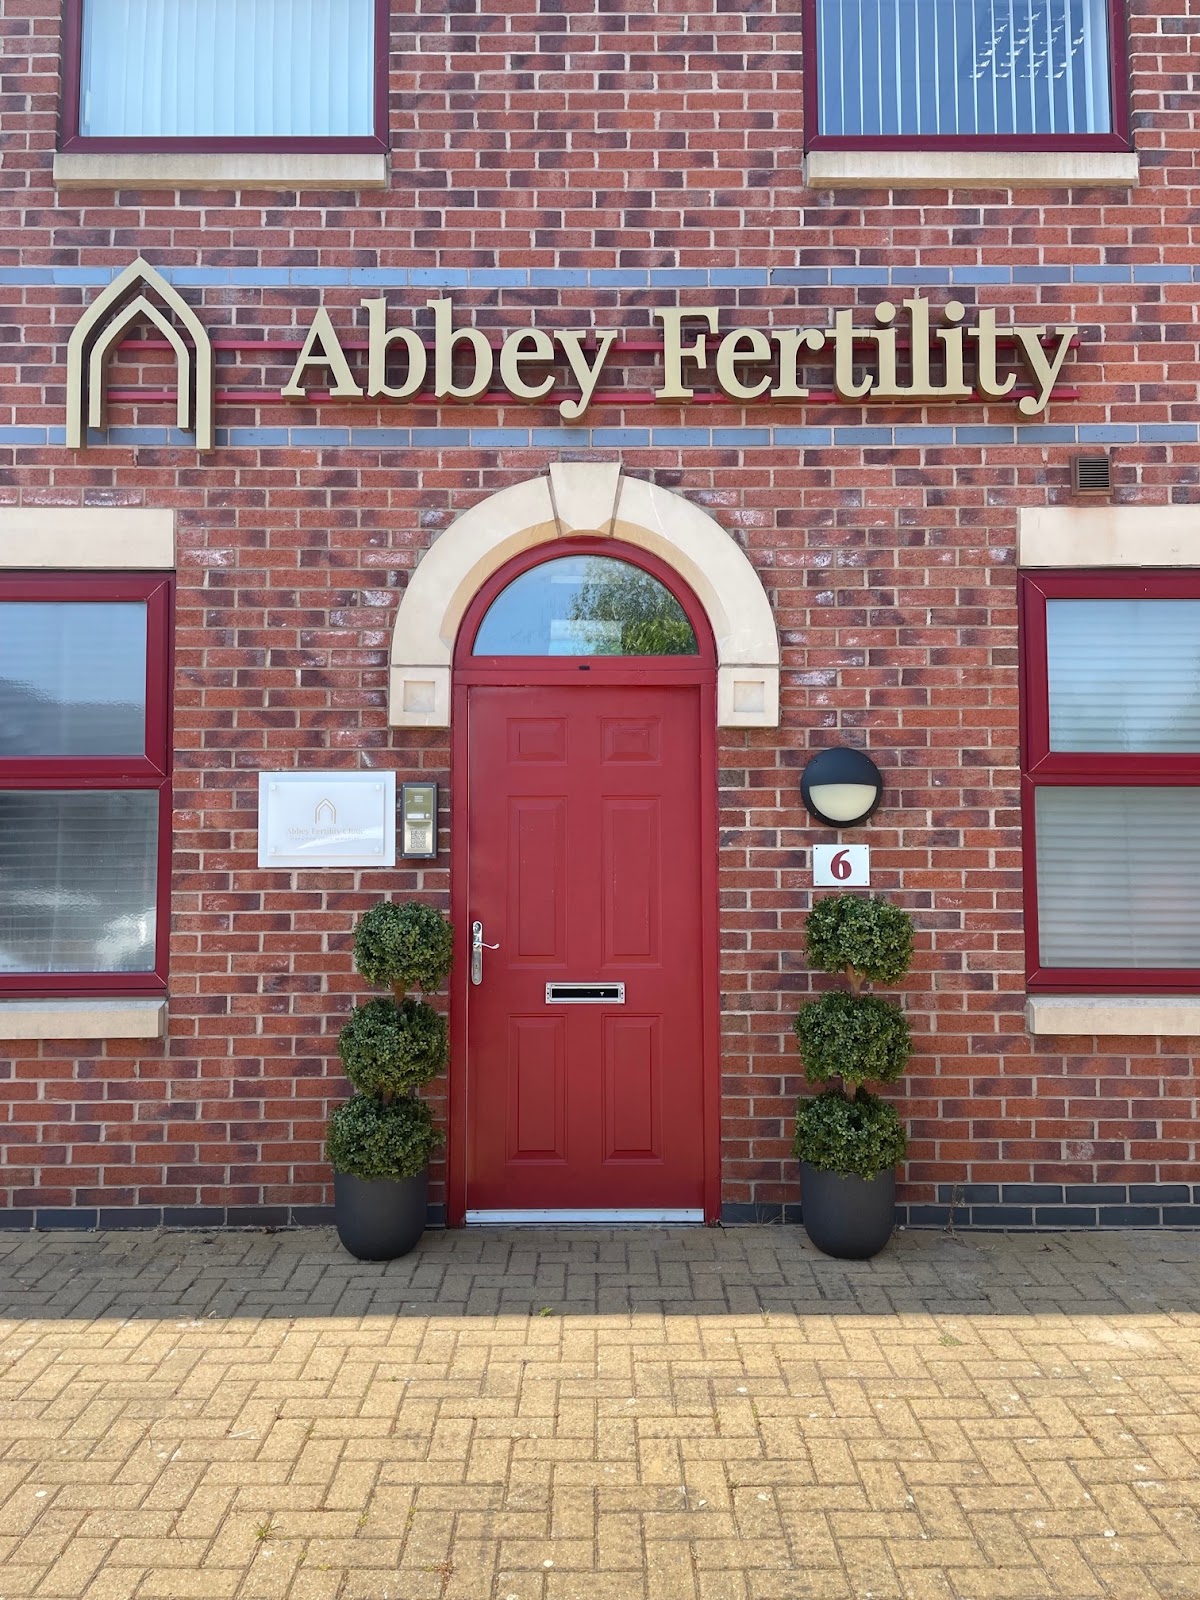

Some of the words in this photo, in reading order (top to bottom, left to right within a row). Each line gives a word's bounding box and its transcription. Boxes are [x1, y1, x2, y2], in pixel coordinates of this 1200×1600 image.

[281, 298, 617, 420] Abbey
[654, 296, 1078, 417] Fertility
[831, 849, 852, 880] 6
